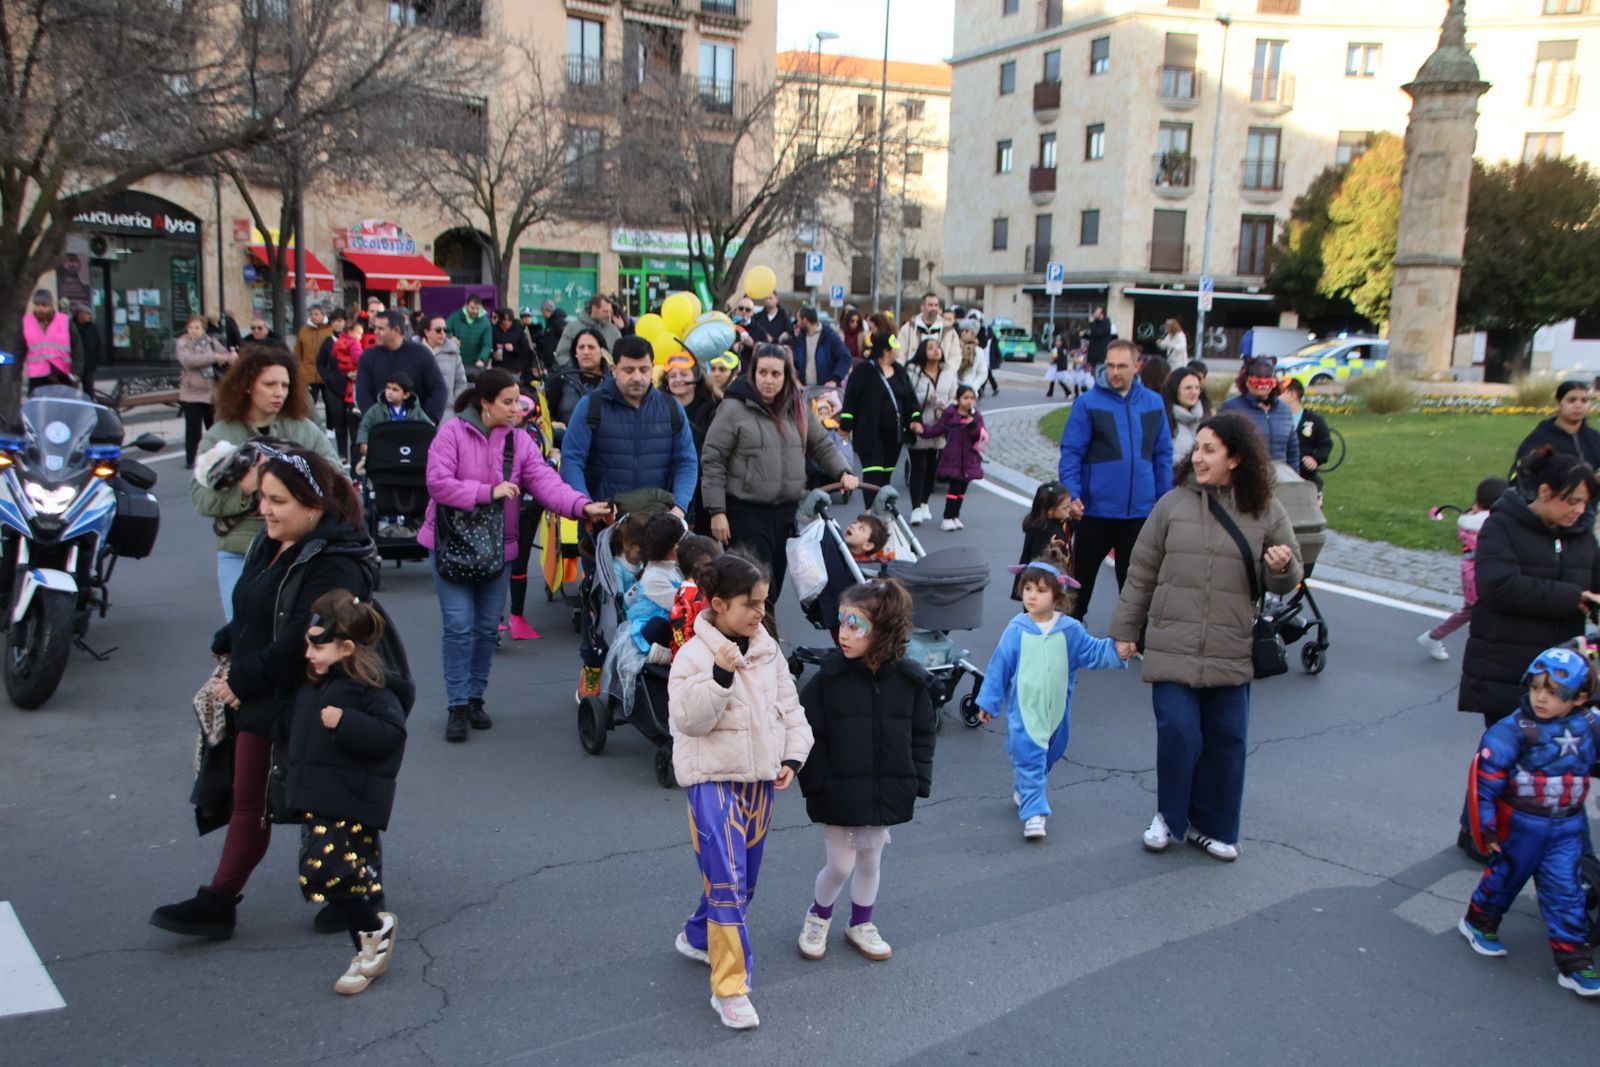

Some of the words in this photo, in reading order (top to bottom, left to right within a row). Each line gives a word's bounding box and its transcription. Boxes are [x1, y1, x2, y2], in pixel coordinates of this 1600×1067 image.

[154, 213, 196, 234] Alysa
[810, 255, 821, 270] P
[1050, 264, 1061, 280] P
[833, 287, 842, 299] P
